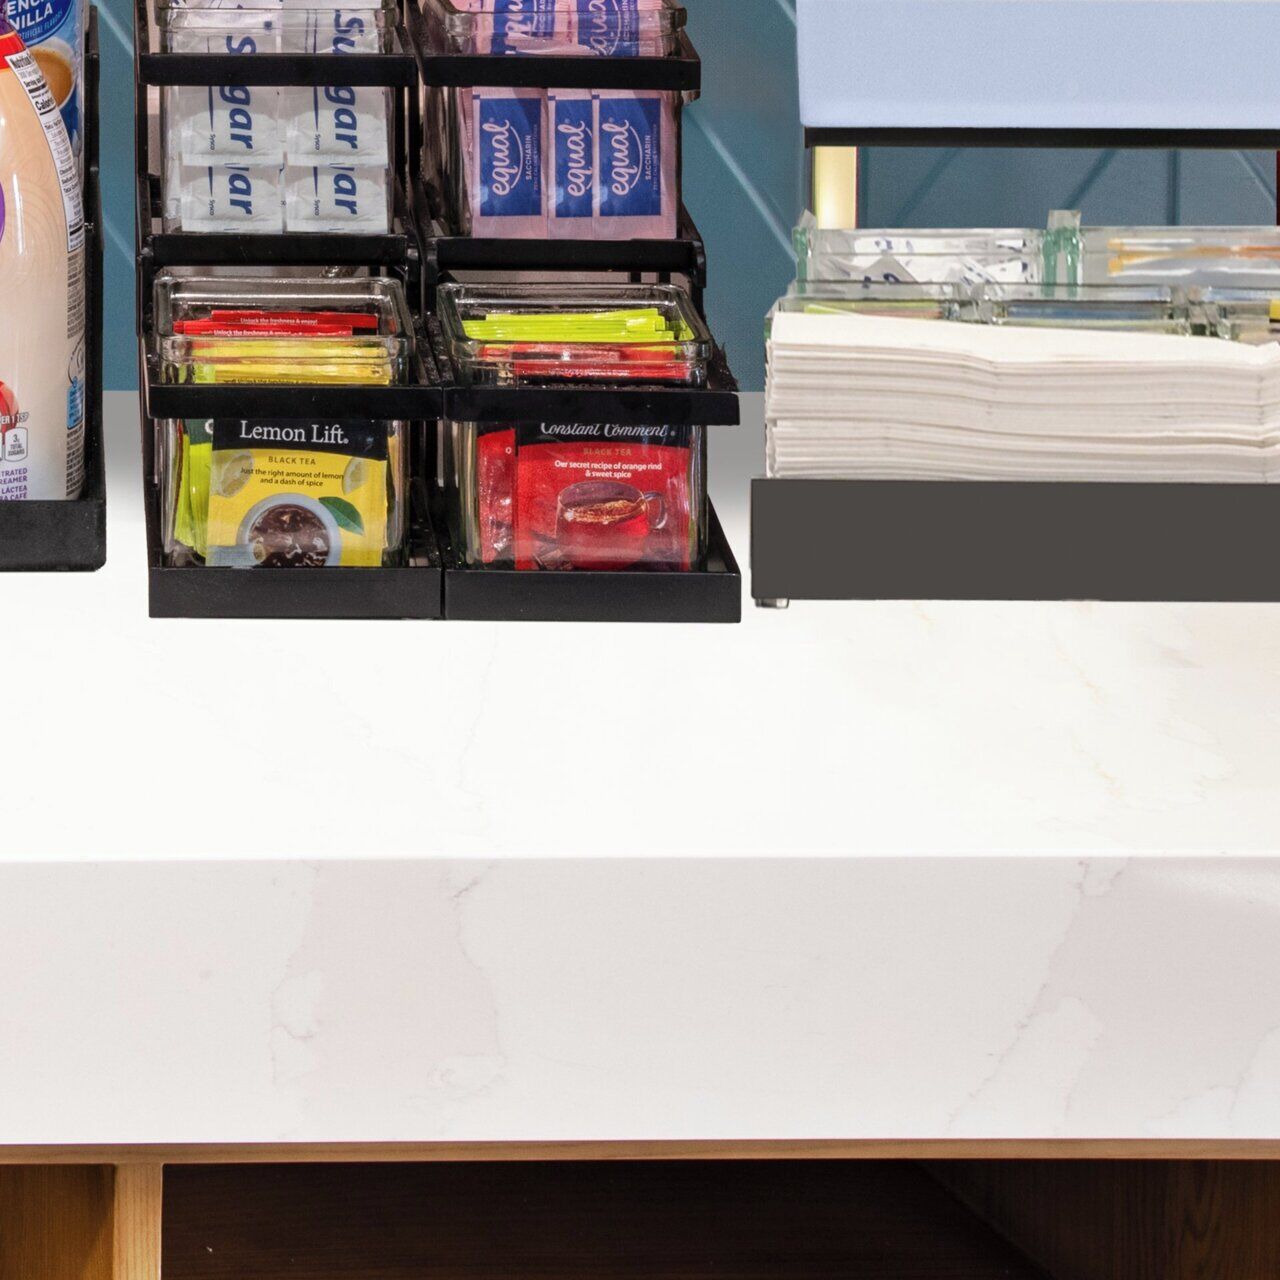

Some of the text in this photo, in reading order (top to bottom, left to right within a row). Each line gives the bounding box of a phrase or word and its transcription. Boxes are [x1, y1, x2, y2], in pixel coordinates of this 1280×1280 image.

[11, 3, 53, 31] NILLA
[482, 119, 519, 196] equal
[557, 120, 593, 197] equal
[601, 119, 639, 196] equal
[644, 134, 652, 181] SACCHARIN
[260, 317, 270, 325] the
[269, 317, 296, 325] freshness
[240, 420, 306, 442] Lemon
[540, 422, 668, 437] Constant Comment
[583, 448, 632, 456] BLACK TEA
[268, 456, 317, 466] BLACK TEA
[554, 460, 662, 472] Our secret recipe of orange rind
[255, 468, 267, 476] the
[267, 469, 285, 478] right
[285, 470, 312, 478] amount
[312, 471, 322, 479] of
[322, 472, 344, 480] lemon
[591, 470, 613, 478] sweet
[613, 470, 632, 479] spice
[297, 478, 306, 486] of
[306, 479, 324, 488] spice
